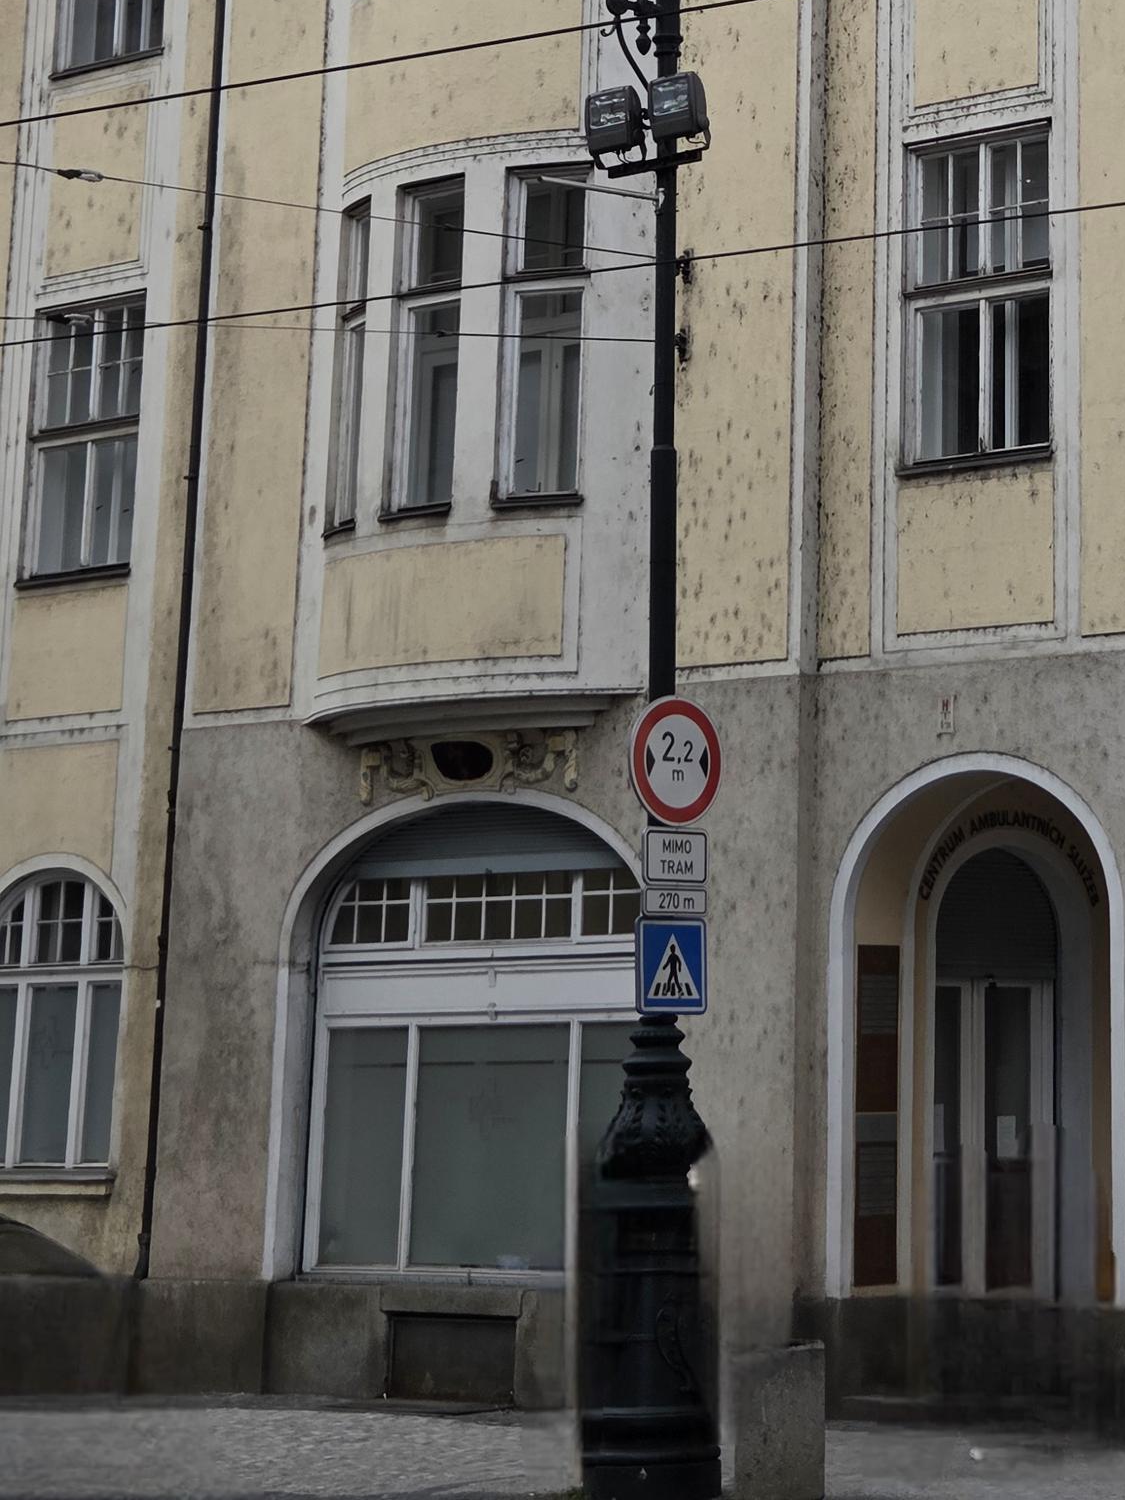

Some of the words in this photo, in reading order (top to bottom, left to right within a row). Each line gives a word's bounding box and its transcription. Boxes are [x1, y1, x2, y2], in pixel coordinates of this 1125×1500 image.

[662, 731, 693, 764] 2,2
[672, 769, 684, 781] m
[662, 838, 692, 855] MIMO
[918, 826, 965, 900] CENTRUM
[970, 809, 1066, 850] AMBULANTNÍCH
[1067, 845, 1100, 907] SLUŽEB
[660, 859, 694, 875] TRAM
[658, 892, 681, 910] 270
[683, 898, 695, 910] m
